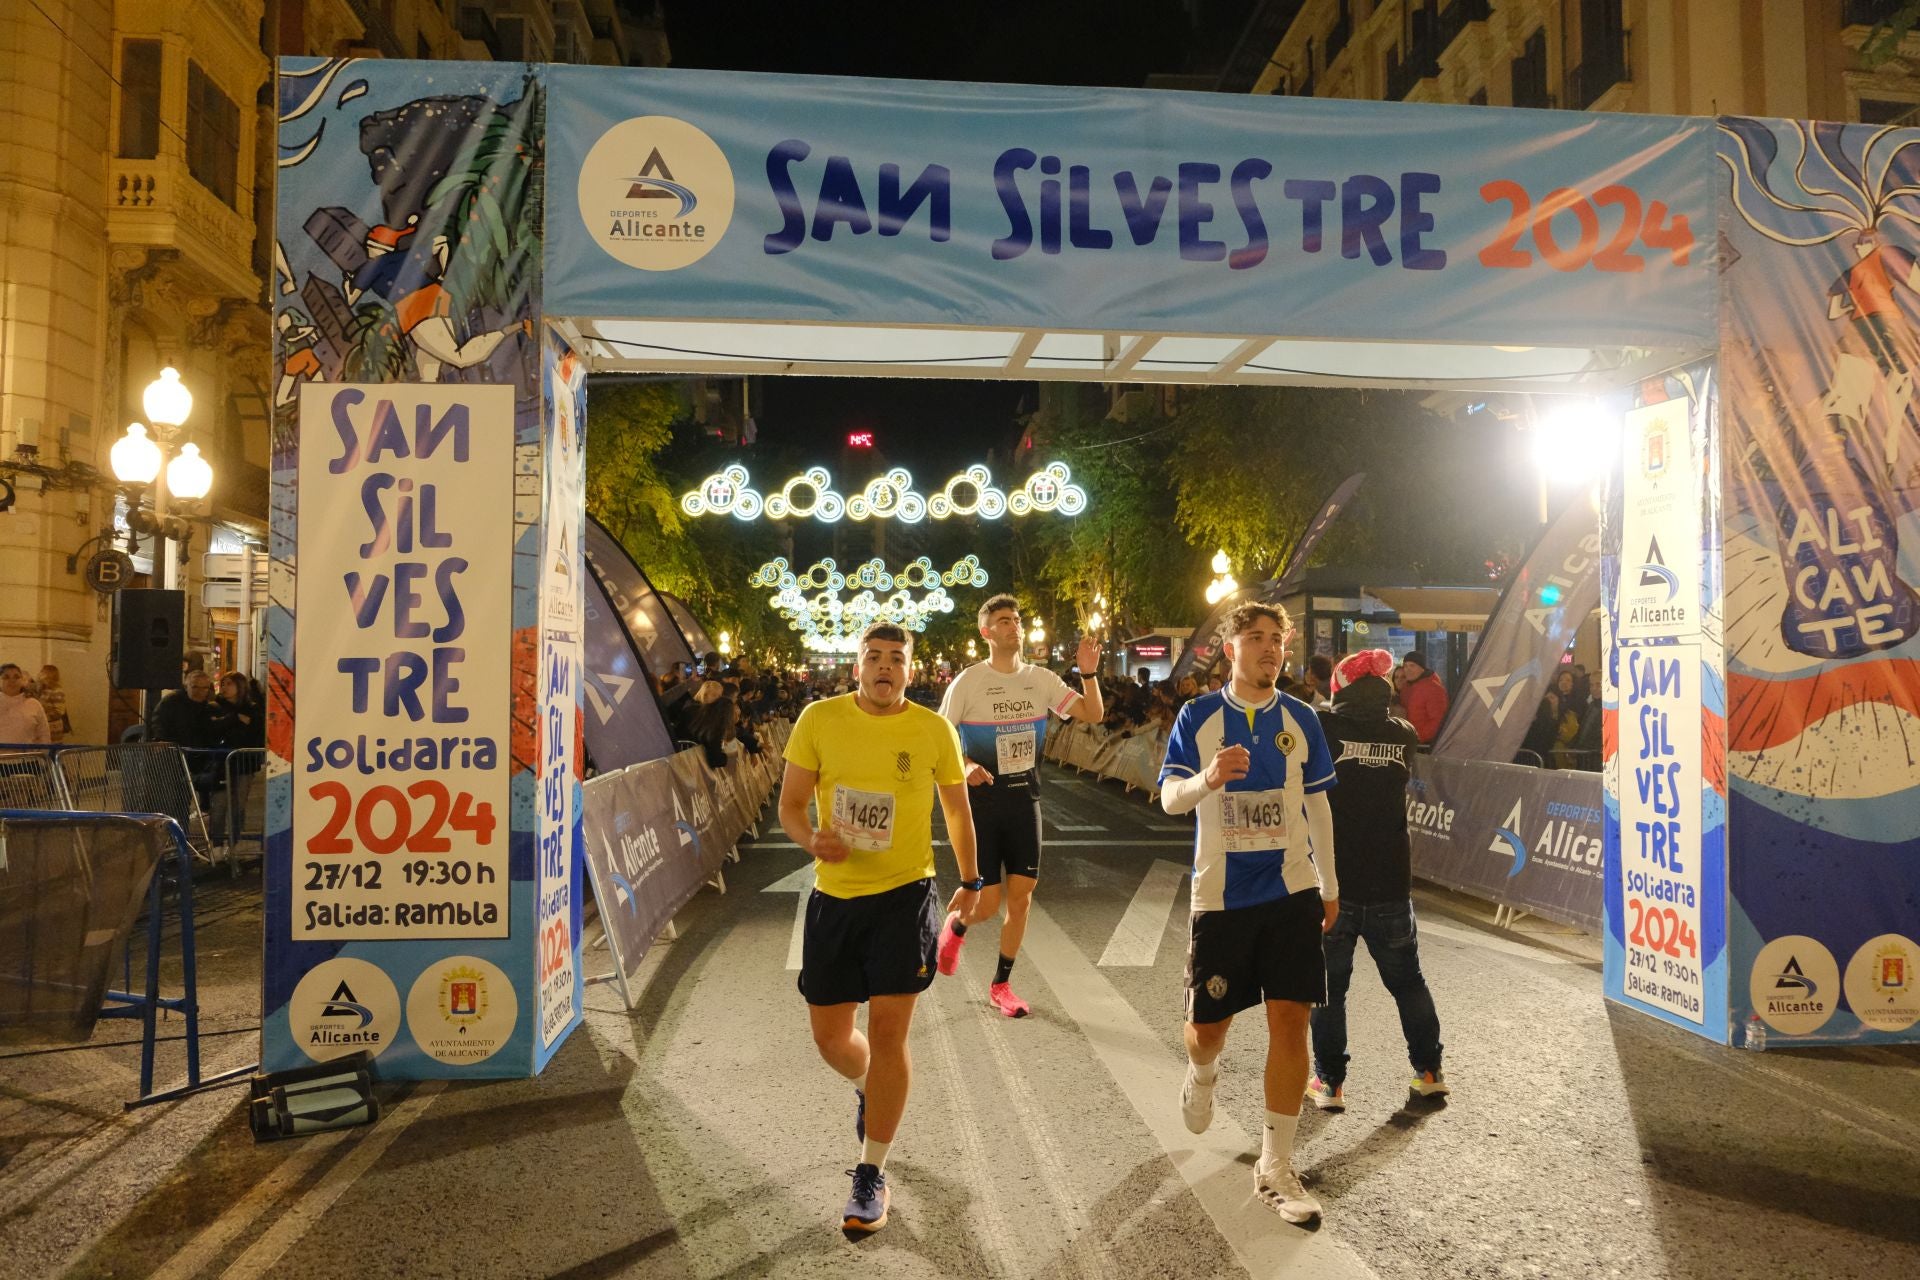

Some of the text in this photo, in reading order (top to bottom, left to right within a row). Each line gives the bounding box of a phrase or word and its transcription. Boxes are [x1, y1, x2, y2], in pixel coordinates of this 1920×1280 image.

[610, 210, 658, 218] DEPORTES
[763, 138, 951, 255] SAN
[1478, 179, 1694, 273] 2024
[609, 219, 705, 237] Alicante
[328, 388, 470, 474] SAN
[1787, 505, 1882, 557] ALI
[99, 561, 120, 582] B
[1795, 559, 1893, 610] CAN
[343, 557, 469, 644] VES
[1630, 605, 1685, 623] Alicante
[1798, 603, 1904, 652] TE
[337, 647, 469, 724] TRE
[546, 643, 569, 705] SAN
[1628, 650, 1681, 704] SAN
[993, 699, 1034, 713] PEÑOTA
[995, 722, 1036, 733] ALUSIGMA
[1011, 740, 1033, 759] 2739
[545, 762, 565, 823] VES
[1635, 761, 1681, 819] VES
[306, 779, 497, 855] 2024
[849, 802, 889, 830] 1462
[1242, 802, 1282, 829] 1463
[1546, 801, 1601, 824] DEPORTES
[543, 825, 564, 881] TRE
[620, 823, 660, 880] Alicante
[1534, 820, 1604, 867] Alica
[1635, 821, 1683, 874] TRE
[304, 860, 496, 890] 27/12 19:30 h
[304, 901, 498, 931] Salida: Rambla
[1629, 898, 1697, 959] 2024
[541, 917, 570, 985] 2024
[1630, 948, 1699, 985] 27/12 19:30 h
[1628, 972, 1660, 998] Salida:
[1768, 1000, 1824, 1013] Alicante
[1864, 1008, 1919, 1016] AYUNTAMIENTO
[310, 1031, 380, 1043] Alicante
[429, 1039, 495, 1048] AYUNTAMIENTO
[435, 1049, 490, 1058] DE ALICANTE
